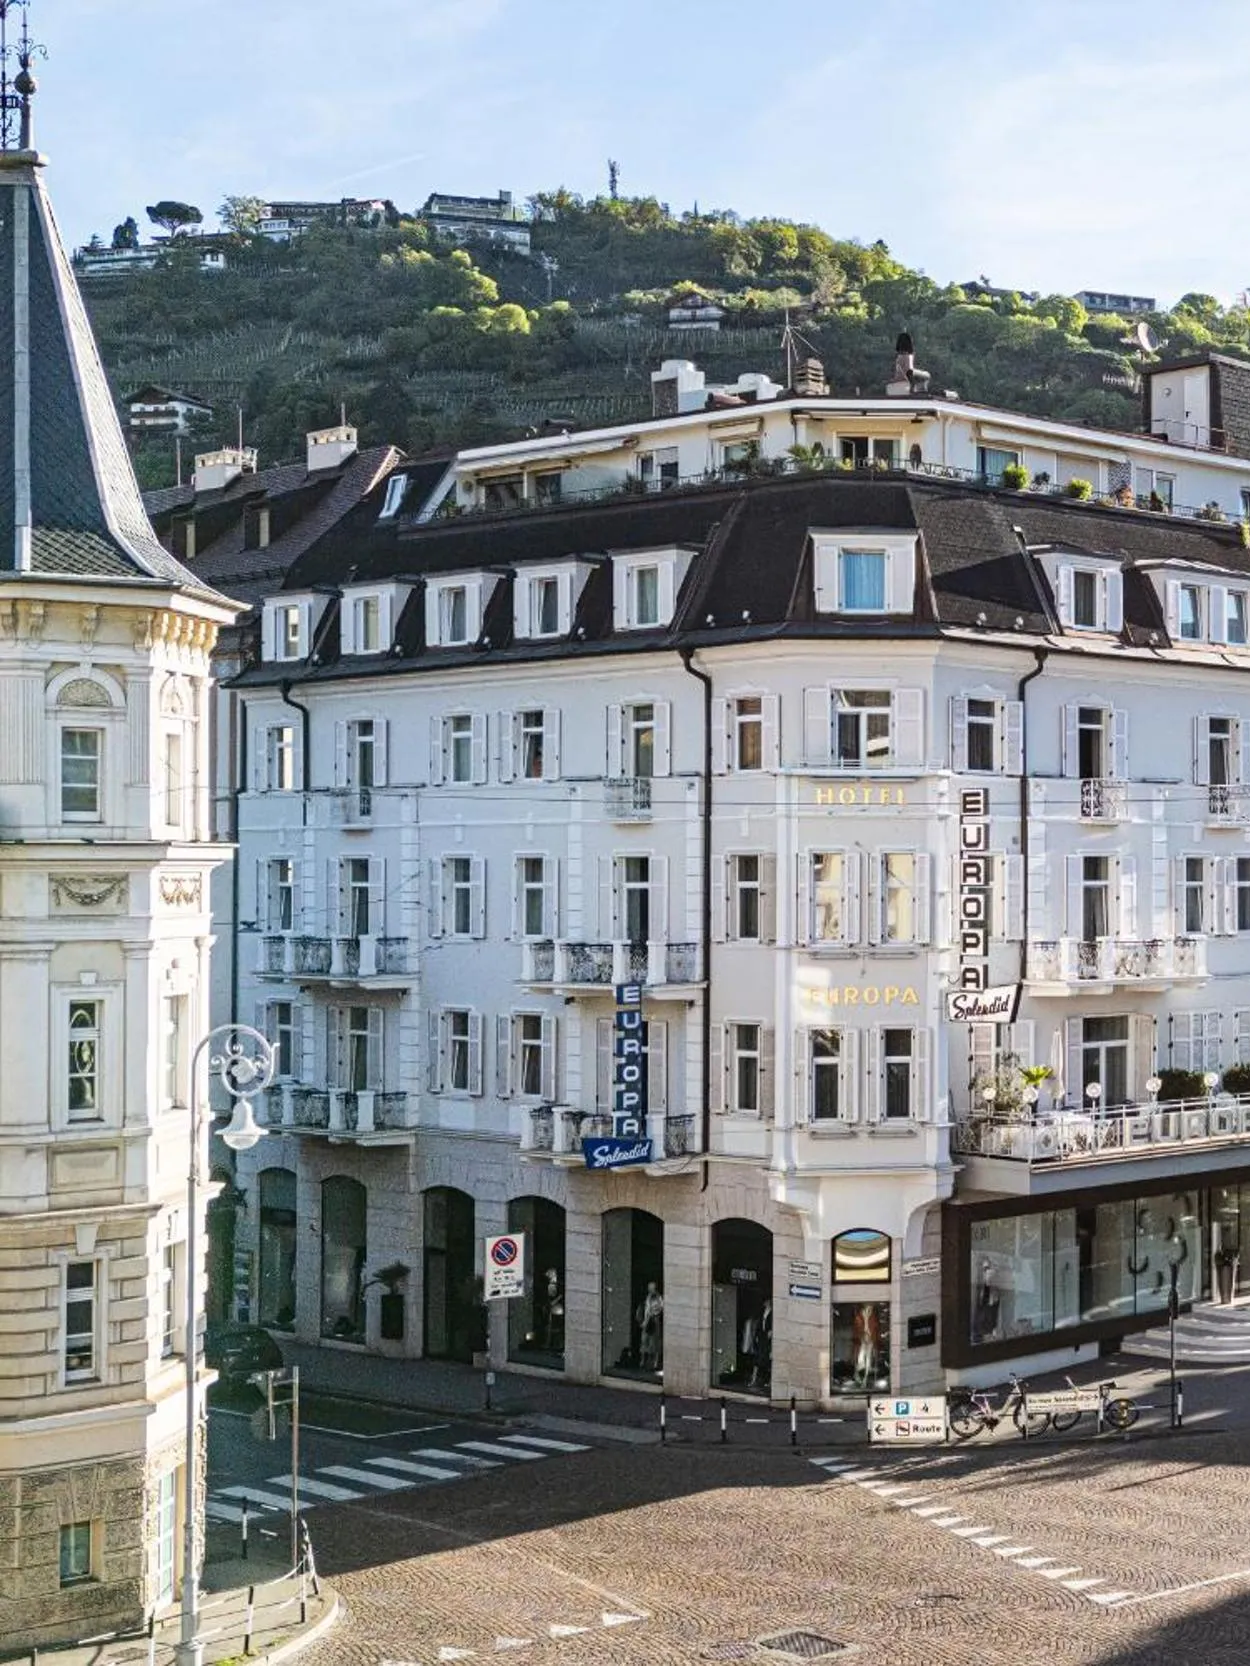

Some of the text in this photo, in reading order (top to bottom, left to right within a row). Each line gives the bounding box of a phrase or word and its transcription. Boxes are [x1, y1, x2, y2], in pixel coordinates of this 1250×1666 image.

[815, 786, 905, 805] HOTEL
[961, 790, 983, 990] EUROPA
[803, 986, 919, 1005] EUROPA
[951, 993, 1011, 1020] Splendid
[622, 985, 641, 1135] EUROPA
[593, 1141, 650, 1168] Splendid
[899, 1402, 907, 1413] P
[912, 1424, 941, 1433] Route
